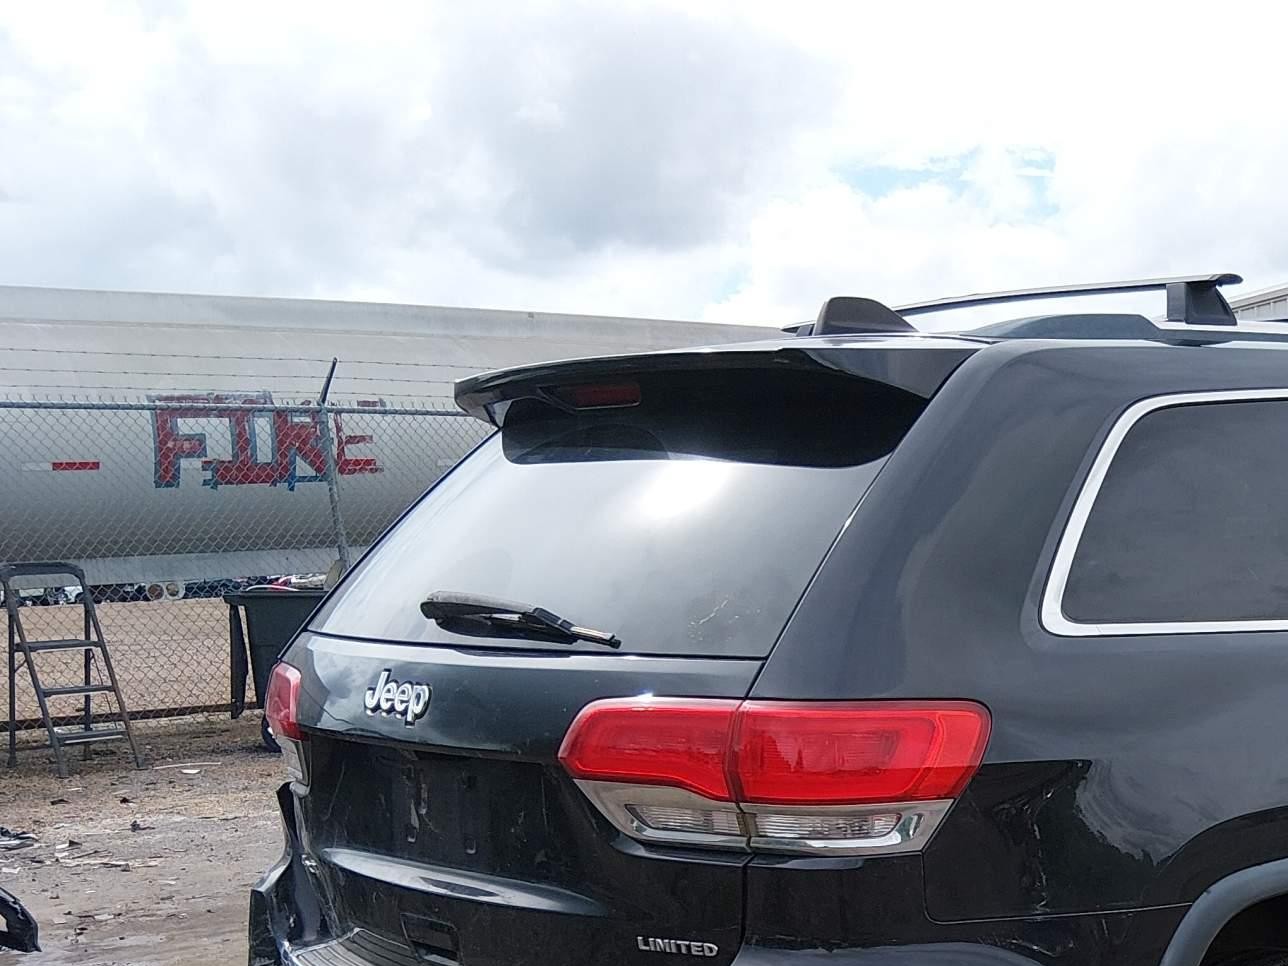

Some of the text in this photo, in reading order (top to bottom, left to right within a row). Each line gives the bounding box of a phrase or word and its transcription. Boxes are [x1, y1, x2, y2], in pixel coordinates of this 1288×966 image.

[150, 391, 384, 491] FIRE
[364, 668, 432, 726] Jeep
[637, 936, 719, 957] LIMITED
